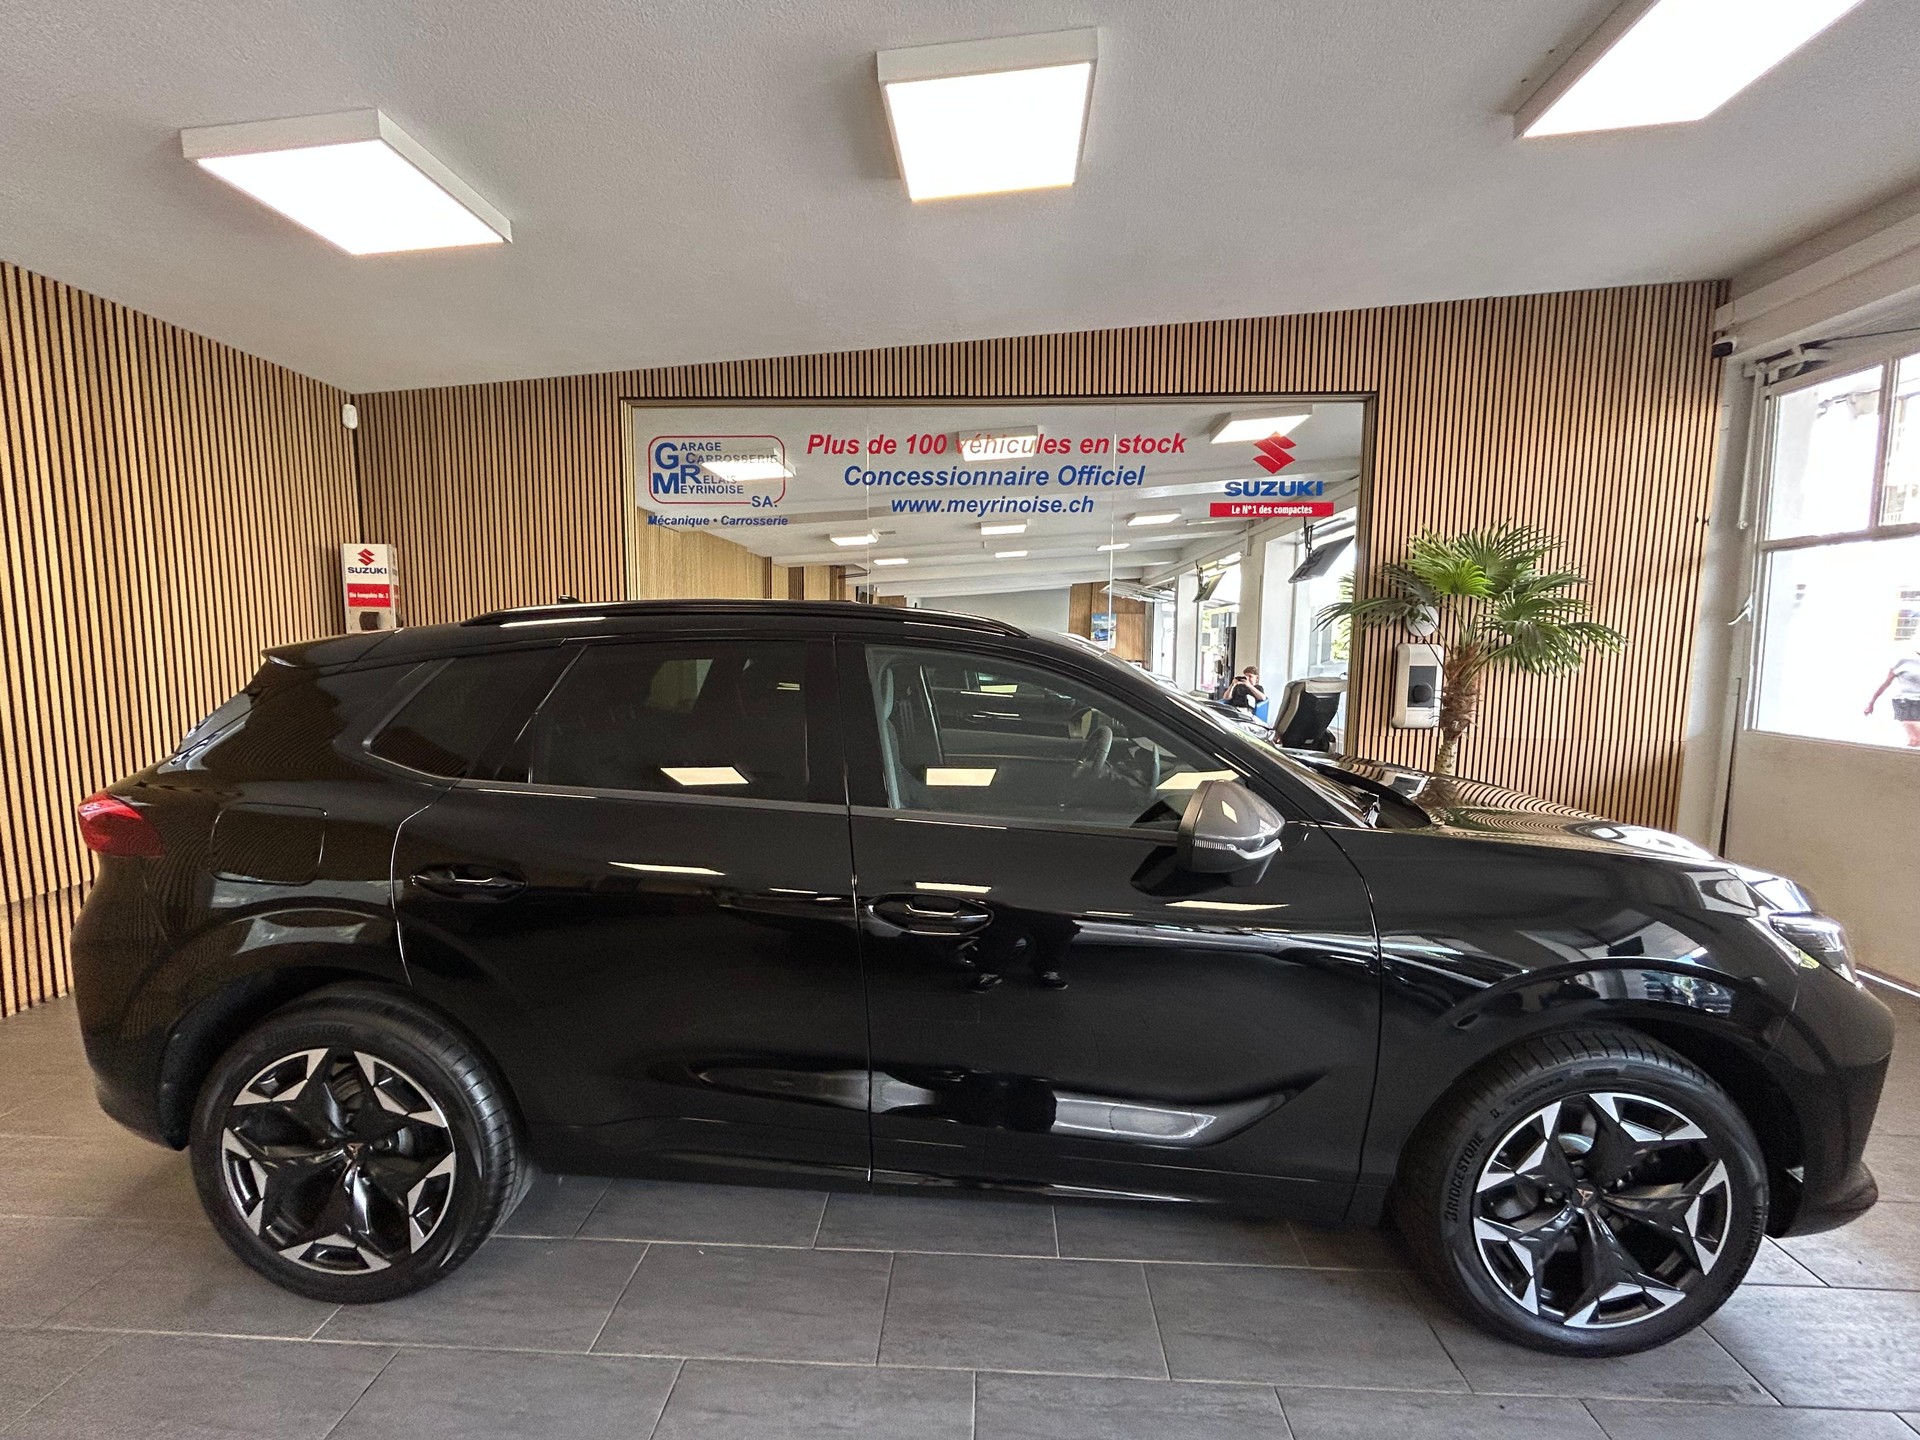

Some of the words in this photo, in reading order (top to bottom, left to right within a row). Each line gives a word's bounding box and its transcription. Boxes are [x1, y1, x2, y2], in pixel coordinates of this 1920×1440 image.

[806, 433, 860, 455] Plus
[867, 433, 897, 455] de
[905, 433, 948, 455] 100
[955, 432, 1072, 455] véhicules
[1079, 437, 1110, 455] en
[1116, 432, 1188, 454] stock
[685, 452, 778, 464] CARROSSERIE
[844, 464, 1050, 486] Concessionnaire
[1057, 464, 1146, 486] Officiel
[1223, 480, 1324, 497] SUZUKI
[891, 495, 1094, 518] www.meyrinoise.ch
[1231, 505, 1241, 515] Le
[1258, 505, 1273, 515] des
[1273, 505, 1313, 516] compactes
[647, 515, 710, 528] Mécanique
[720, 515, 789, 526] Carrosserie
[1444, 1131, 1486, 1222] BRIDGESTONE
